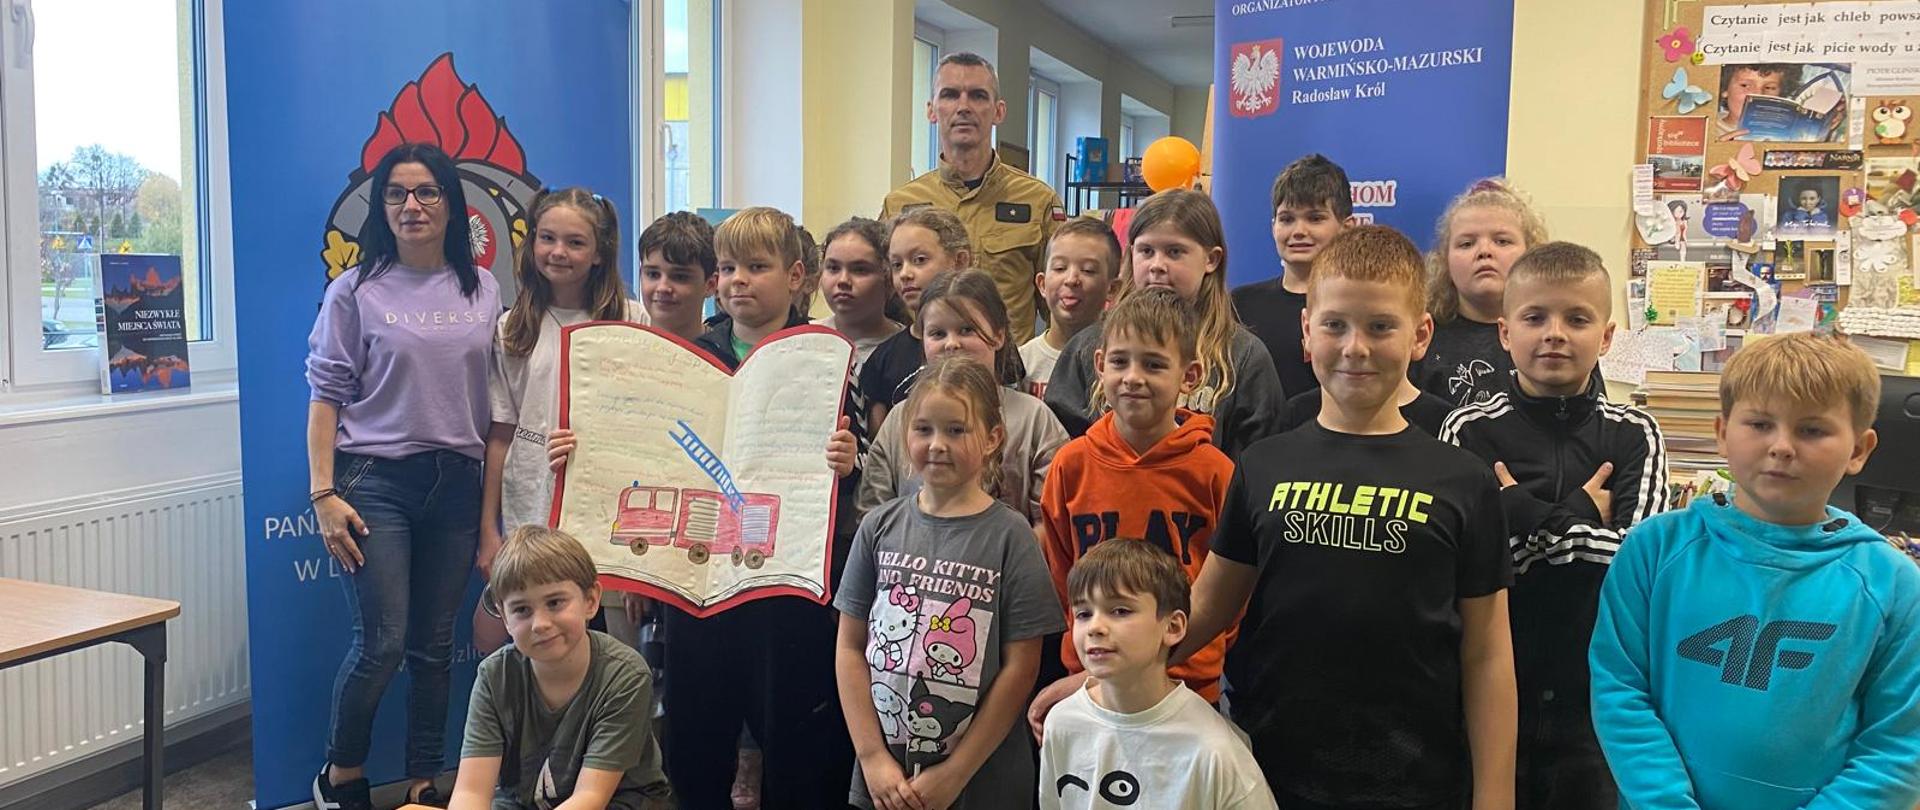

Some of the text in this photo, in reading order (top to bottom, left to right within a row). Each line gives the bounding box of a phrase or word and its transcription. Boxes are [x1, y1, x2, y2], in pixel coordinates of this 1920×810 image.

[1710, 14, 1768, 28] Czytanie
[1778, 13, 1801, 26] jest
[1804, 12, 1825, 26] jak
[1834, 11, 1871, 22] chleb
[1294, 37, 1385, 61] WOJEWODA
[1703, 42, 1761, 57] Czytanie
[1768, 41, 1791, 53] jest
[1794, 42, 1815, 54] jak
[1823, 42, 1856, 55] picie
[1859, 42, 1898, 56] wody
[1904, 44, 1913, 52] u
[1293, 47, 1483, 83] WARMIŃSKO-MAZURSKI
[1292, 82, 1386, 105] Radosław Król
[118, 319, 181, 331] MIEJSCA ŚWIATA
[135, 309, 181, 319] NIEZWYKŁE
[384, 311, 489, 324] DIVERSE
[1268, 481, 1434, 524] ATHLETIC
[265, 508, 322, 540] PAŃ
[1284, 510, 1408, 554] SKILLS
[294, 558, 320, 582] W
[932, 559, 1001, 585] KITTY
[908, 573, 994, 603] FRIENDS
[1676, 614, 1838, 692] 4F
